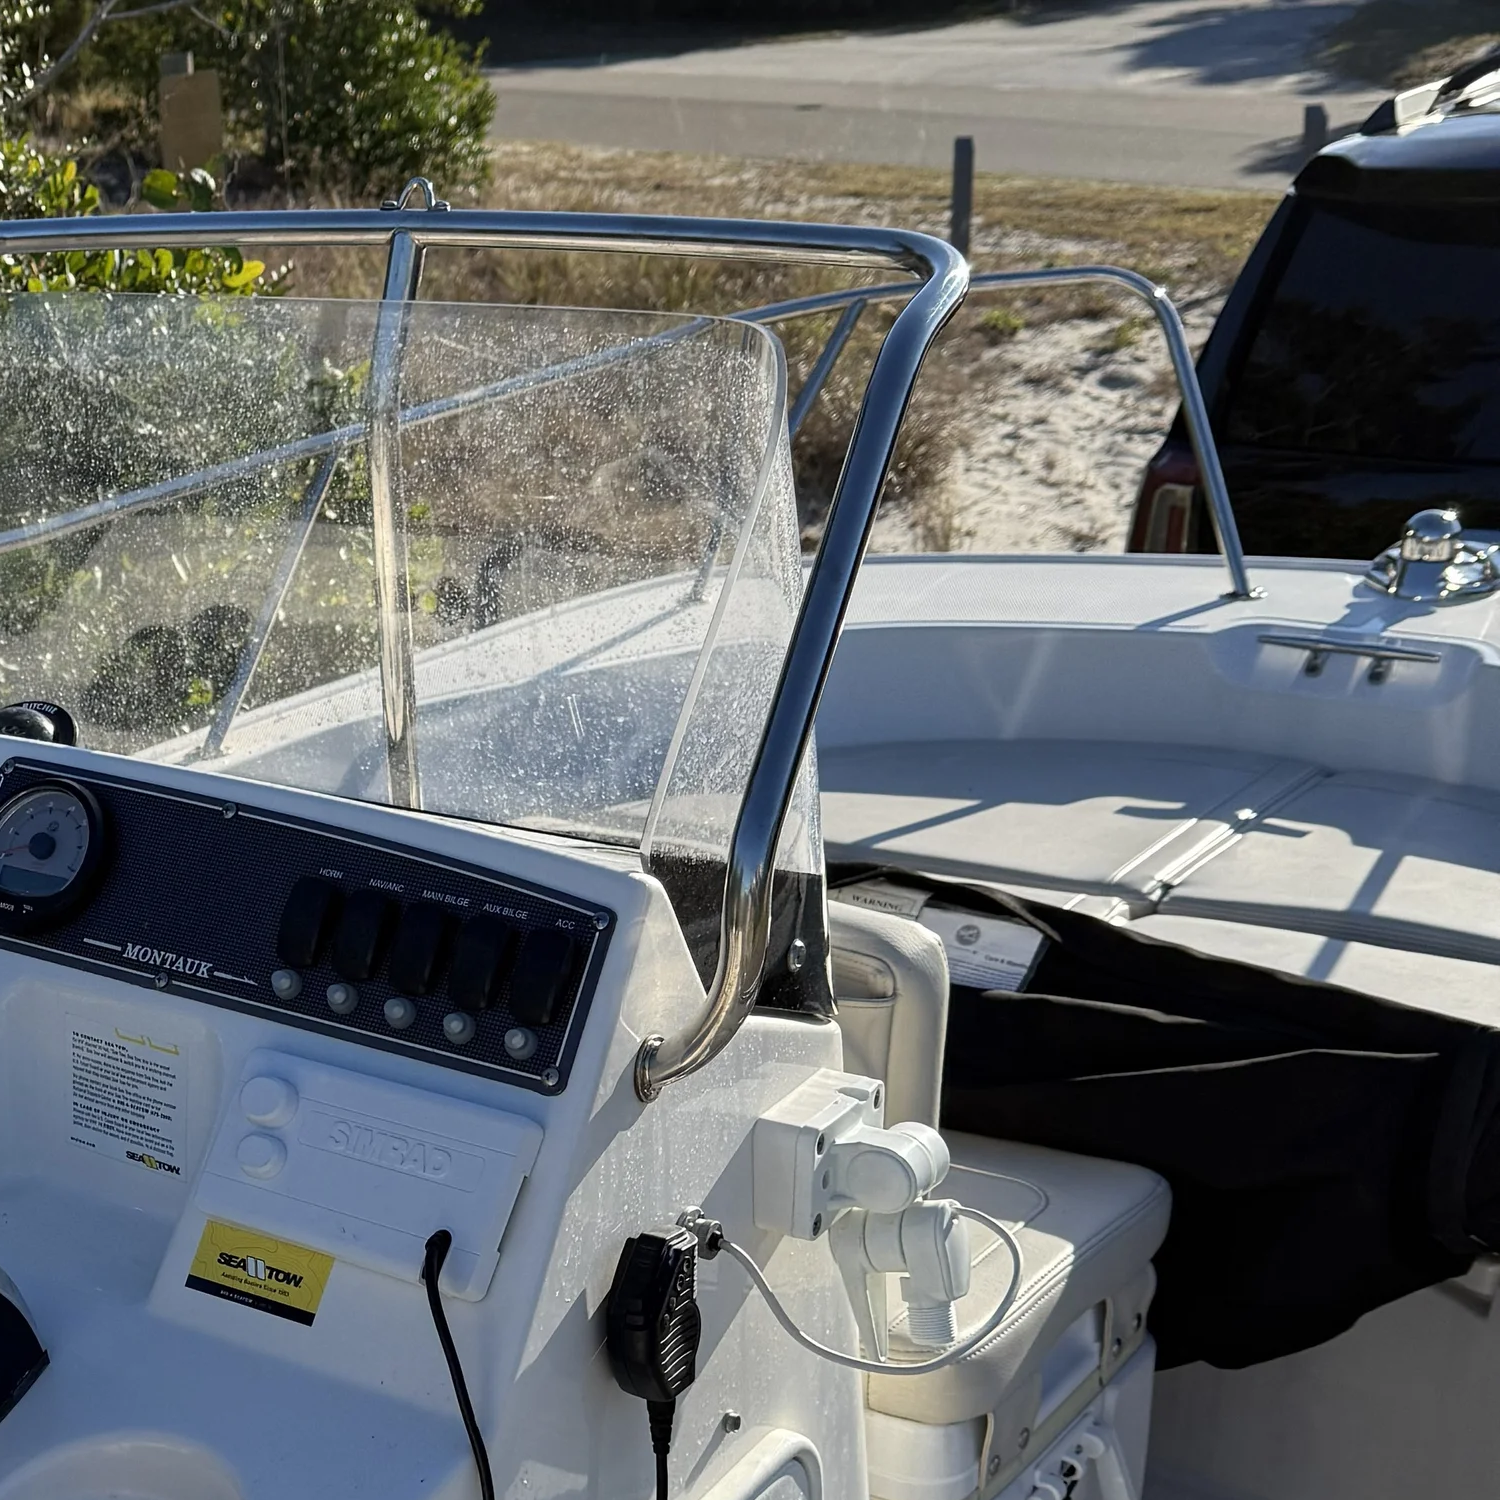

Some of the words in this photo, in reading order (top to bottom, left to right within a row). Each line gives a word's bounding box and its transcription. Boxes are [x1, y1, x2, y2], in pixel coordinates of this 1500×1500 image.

[22, 703, 58, 715] RITCHIE
[319, 867, 344, 879] HORN
[369, 878, 405, 893] NAV/ANC
[422, 889, 445, 902] MAIN
[444, 894, 470, 907] BILGE
[852, 894, 902, 911] WARNING
[482, 903, 501, 914] AUX
[502, 907, 529, 920] BILGE
[555, 919, 576, 930] ACC
[122, 943, 213, 978] MONTAUK
[126, 1150, 143, 1162] SEA
[329, 1121, 452, 1178] SIMRAD
[217, 1252, 247, 1272] SEA
